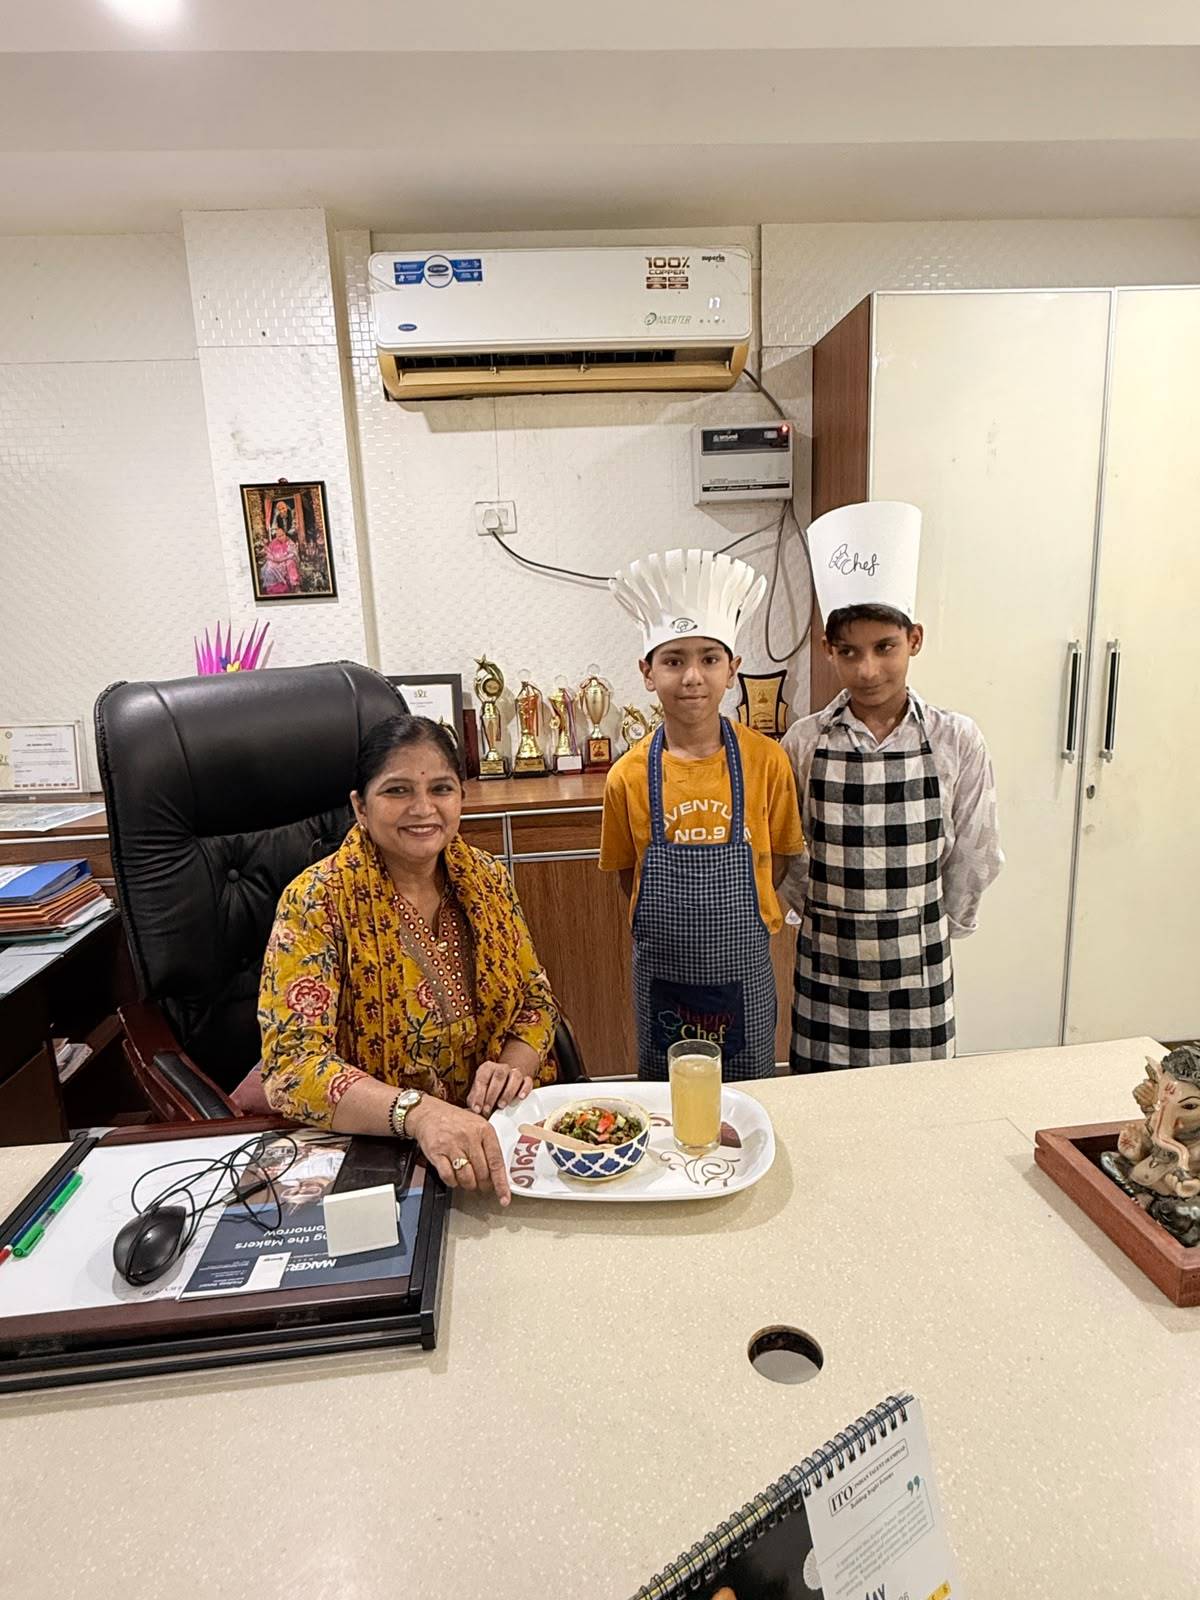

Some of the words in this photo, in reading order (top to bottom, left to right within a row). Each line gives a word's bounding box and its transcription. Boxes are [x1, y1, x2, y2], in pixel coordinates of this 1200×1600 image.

[645, 256, 690, 268] 100%
[841, 552, 880, 577] Chef
[674, 826, 726, 844] NO.9
[680, 1023, 727, 1044] Chef
[264, 1224, 327, 1237] omorrow
[234, 1238, 285, 1250] Makers
[287, 1236, 310, 1244] the
[831, 1485, 853, 1512] ITO
